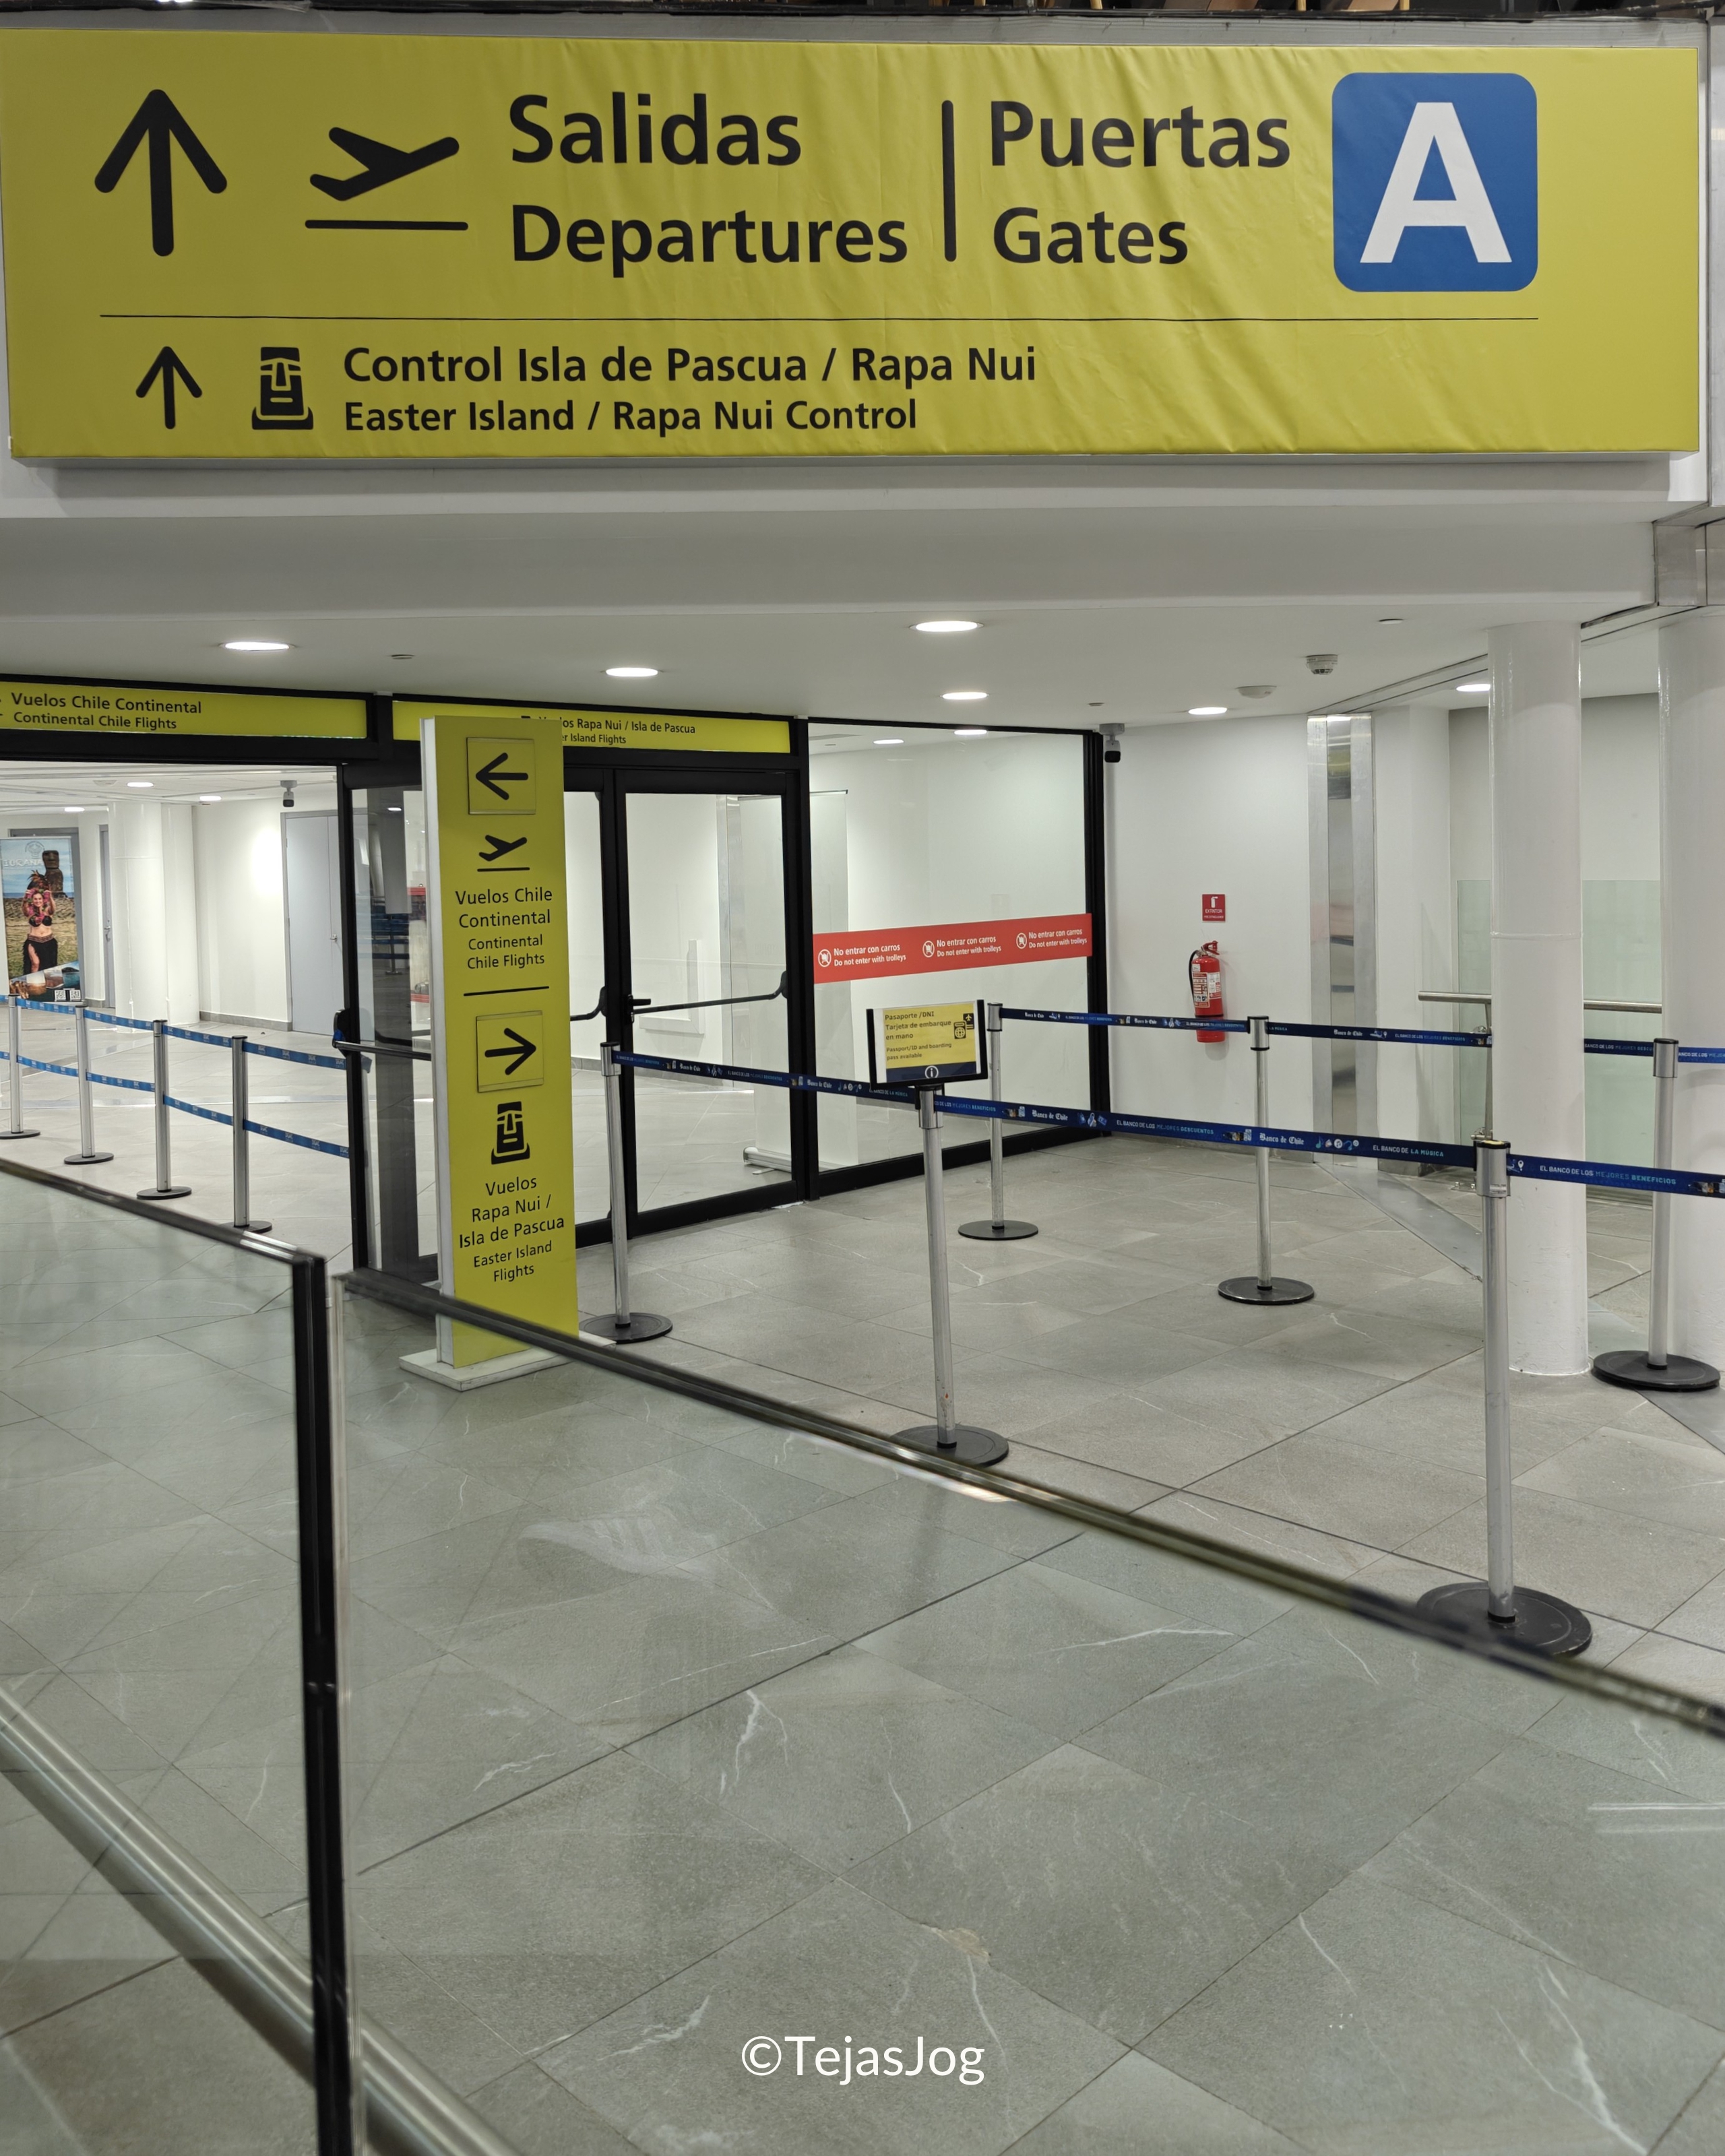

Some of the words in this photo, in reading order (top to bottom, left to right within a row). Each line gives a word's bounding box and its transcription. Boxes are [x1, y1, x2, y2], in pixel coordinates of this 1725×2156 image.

[510, 92, 801, 166] Salidas
[991, 101, 1290, 168] Puertas
[1360, 102, 1513, 263] A
[513, 205, 907, 278] Departures
[994, 207, 1187, 264] Gates
[344, 346, 501, 381] Control
[520, 346, 586, 381] Isla
[602, 346, 652, 381] de
[668, 348, 806, 381] Pascua
[822, 348, 836, 381] /
[853, 348, 951, 389] Rapa
[969, 346, 1034, 380] Nui
[346, 402, 456, 431] Easter
[470, 400, 573, 431] Island
[588, 402, 600, 430] /
[614, 402, 700, 437] Rapa
[715, 400, 772, 429] Nui
[786, 399, 915, 429] Control
[11, 692, 66, 707] Vuelos
[71, 695, 110, 709] Chile
[115, 698, 201, 714] Continental
[13, 711, 94, 726] Continental
[98, 716, 131, 727] Chile
[135, 718, 177, 731] Flights
[577, 718, 602, 731] Rapa
[605, 720, 621, 730] Nui
[631, 722, 647, 732] Isla
[650, 722, 662, 732] de
[664, 723, 695, 734] Pascua
[570, 734, 596, 742] Island
[599, 735, 626, 745] Flights
[456, 889, 509, 905] Vuelos
[515, 887, 553, 902] Chile
[459, 909, 551, 928] Continental
[468, 934, 542, 950] Continental
[937, 939, 946, 947] No
[947, 938, 965, 946] entrar
[978, 936, 997, 944] carros
[1028, 931, 1037, 939] No
[834, 948, 844, 956] No
[845, 947, 866, 955] entrar
[855, 957, 871, 965] enter
[872, 955, 885, 963] with
[468, 956, 499, 969] Chile
[503, 953, 544, 969] Flights
[885, 1013, 918, 1021] Pasaporte
[1032, 1109, 1048, 1118] Banco
[1181, 1127, 1214, 1135] DESCUENTOS
[1259, 1133, 1279, 1143] Banco
[1288, 1137, 1305, 1145] Chile
[485, 1176, 537, 1196] Vuelos
[1596, 1171, 1629, 1180] MEJORES
[1631, 1174, 1676, 1184] BENEFICIOS
[472, 1205, 509, 1223] Rapa
[515, 1196, 540, 1213] Nui
[546, 1194, 551, 1209] /
[460, 1231, 484, 1248] Isla
[490, 1226, 509, 1242] de
[514, 1217, 564, 1237] Pascua
[474, 1251, 512, 1267] Easter
[516, 1240, 552, 1259] Island
[494, 1265, 534, 1282] Flights
